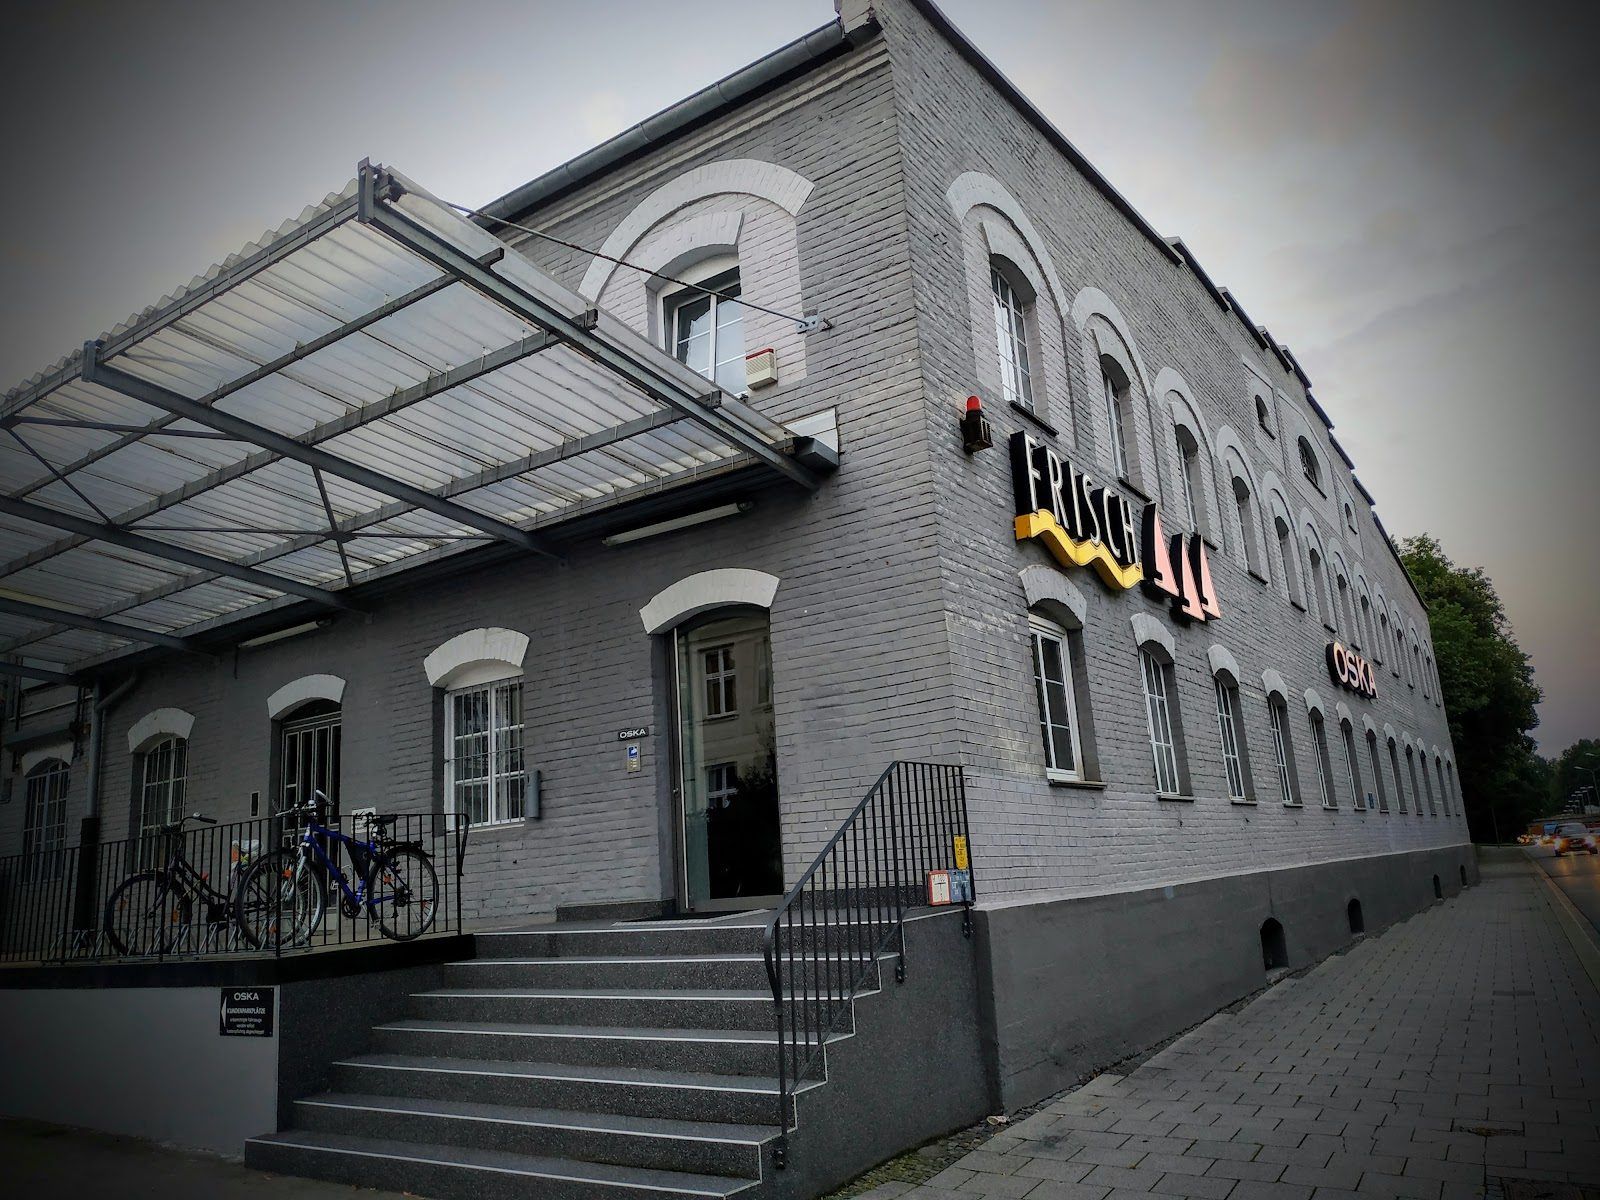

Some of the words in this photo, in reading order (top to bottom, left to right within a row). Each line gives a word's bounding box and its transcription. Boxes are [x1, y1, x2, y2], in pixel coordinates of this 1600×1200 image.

[1023, 433, 1142, 571] FRISCH
[1332, 641, 1379, 699] OSKA
[620, 729, 646, 738] OSKA
[234, 992, 259, 1001] OSKA
